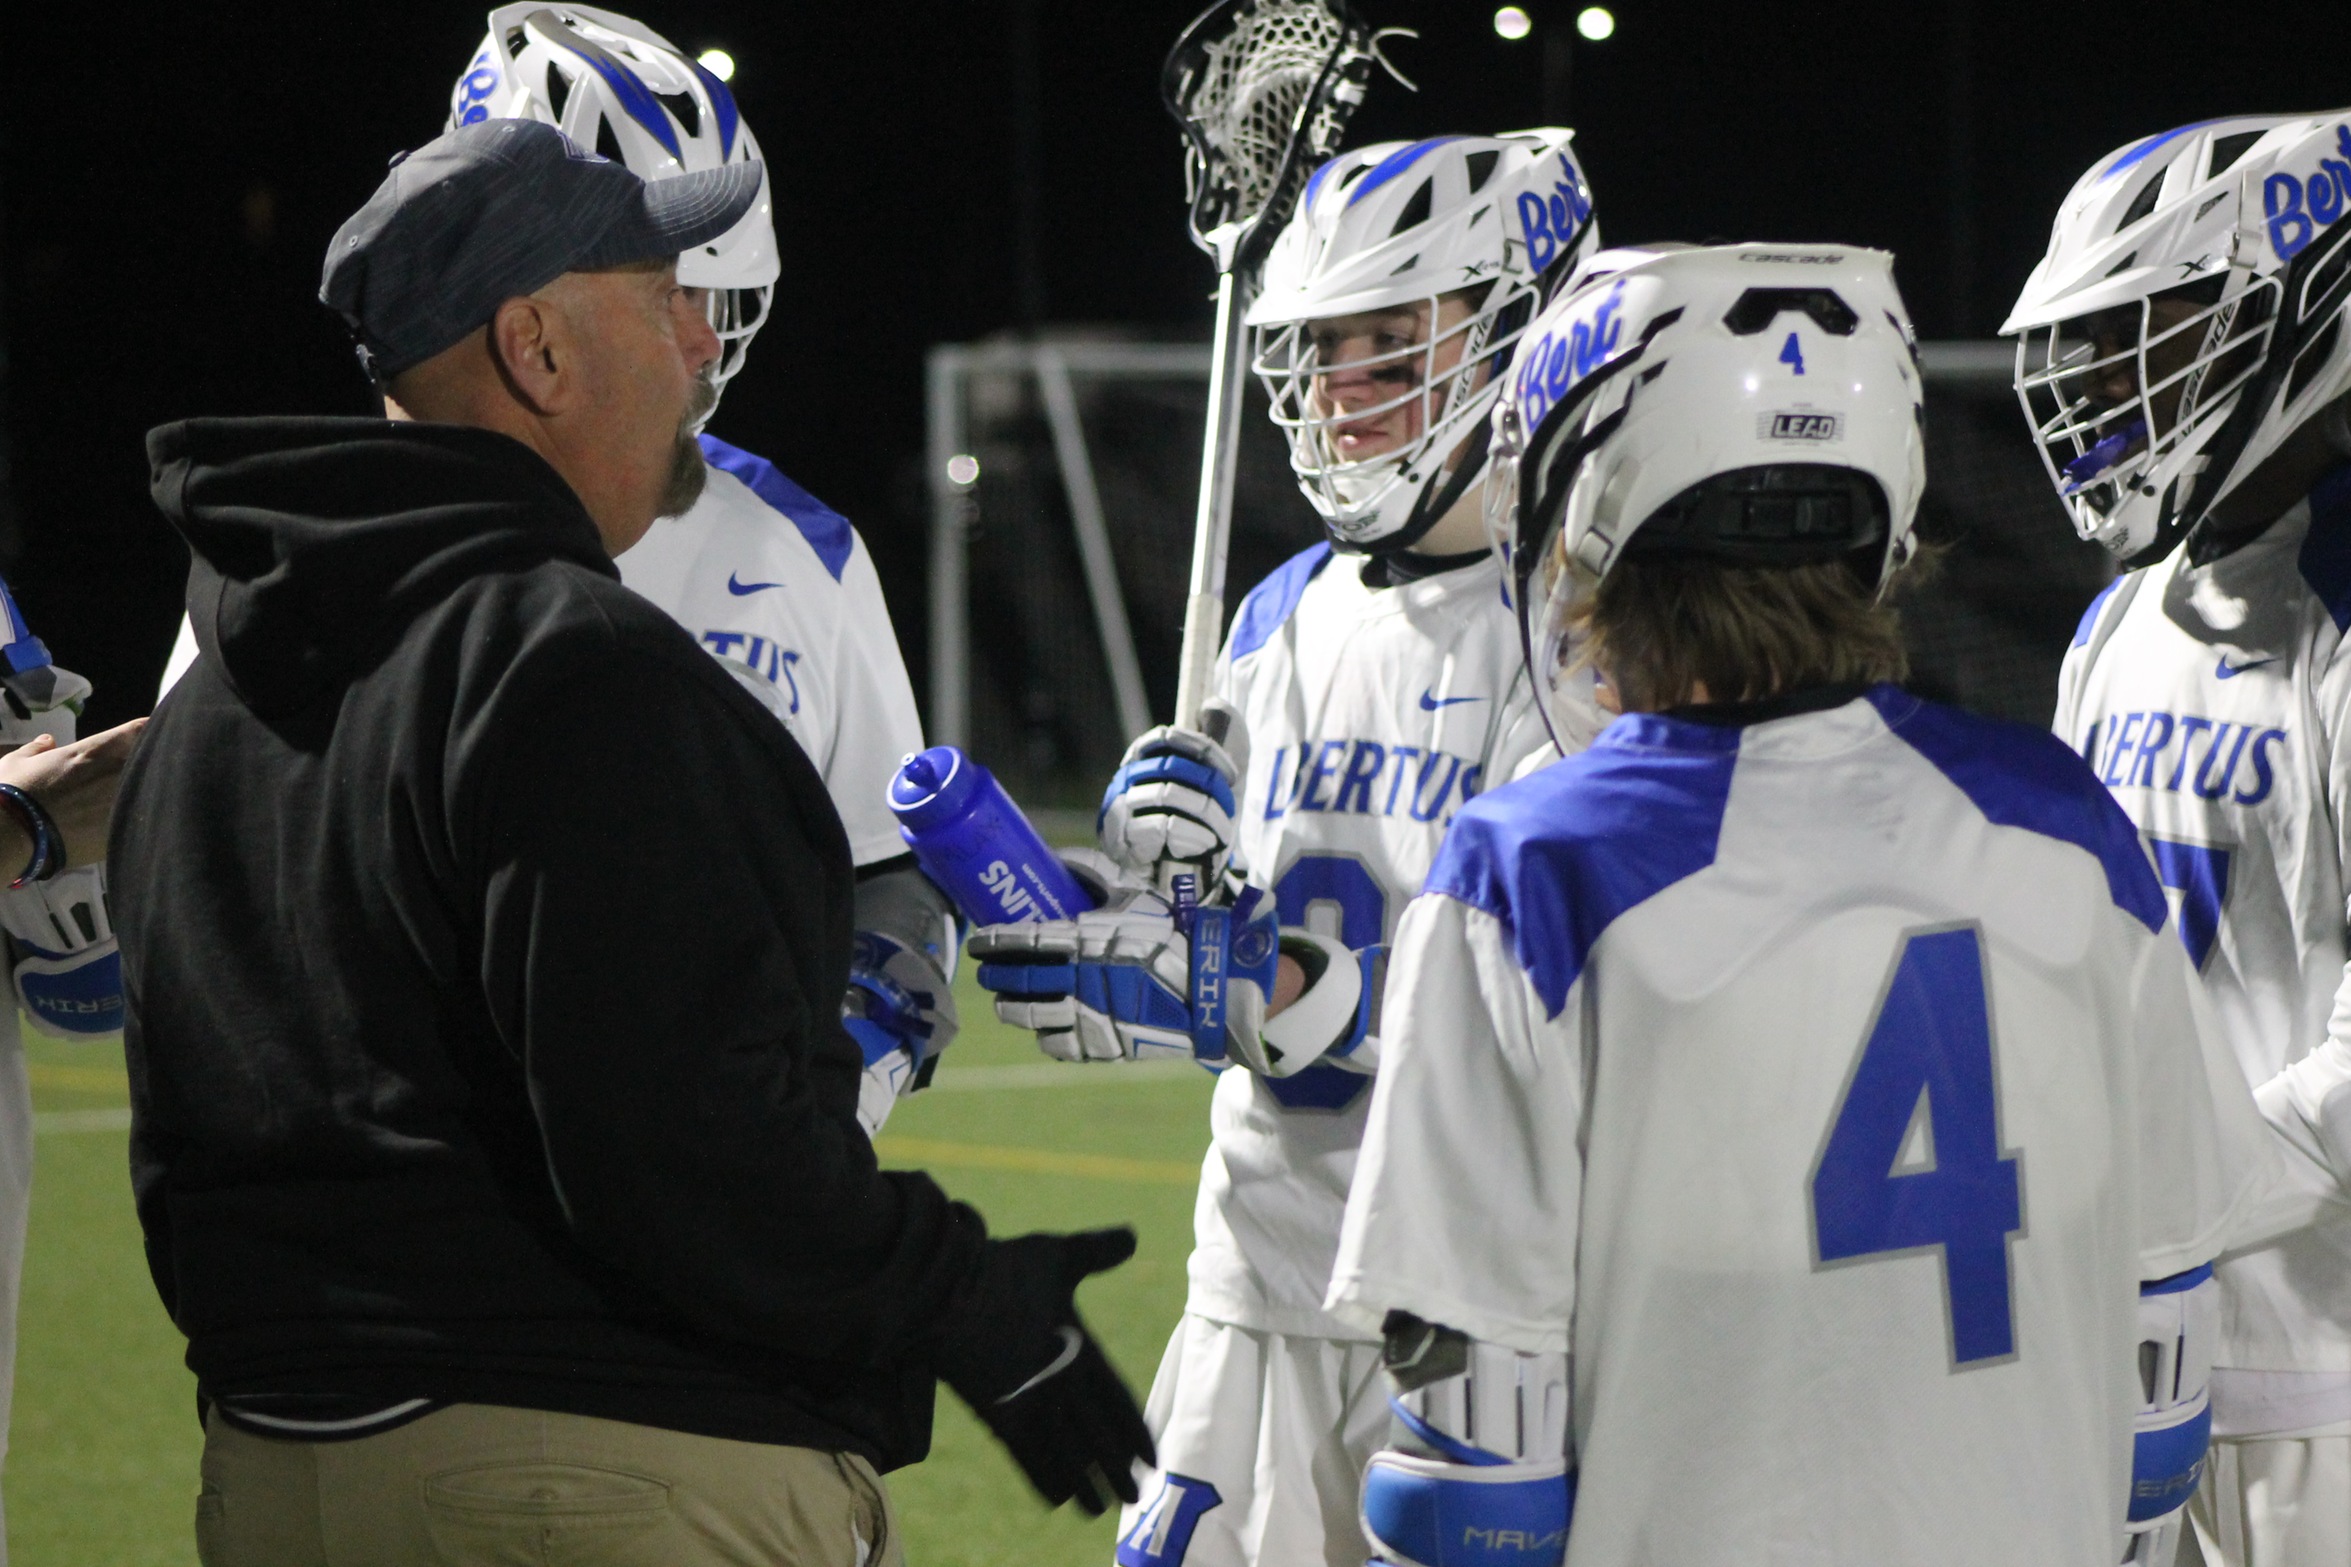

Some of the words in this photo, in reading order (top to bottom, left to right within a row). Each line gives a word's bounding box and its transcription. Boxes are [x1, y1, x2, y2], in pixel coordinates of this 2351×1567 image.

[1517, 152, 1590, 275] Bert
[1738, 252, 1845, 266] cascade
[1517, 278, 1627, 432] Bert
[1778, 332, 1805, 375] 4
[1773, 416, 1835, 438] LEAD
[1804, 918, 2028, 1375] 4
